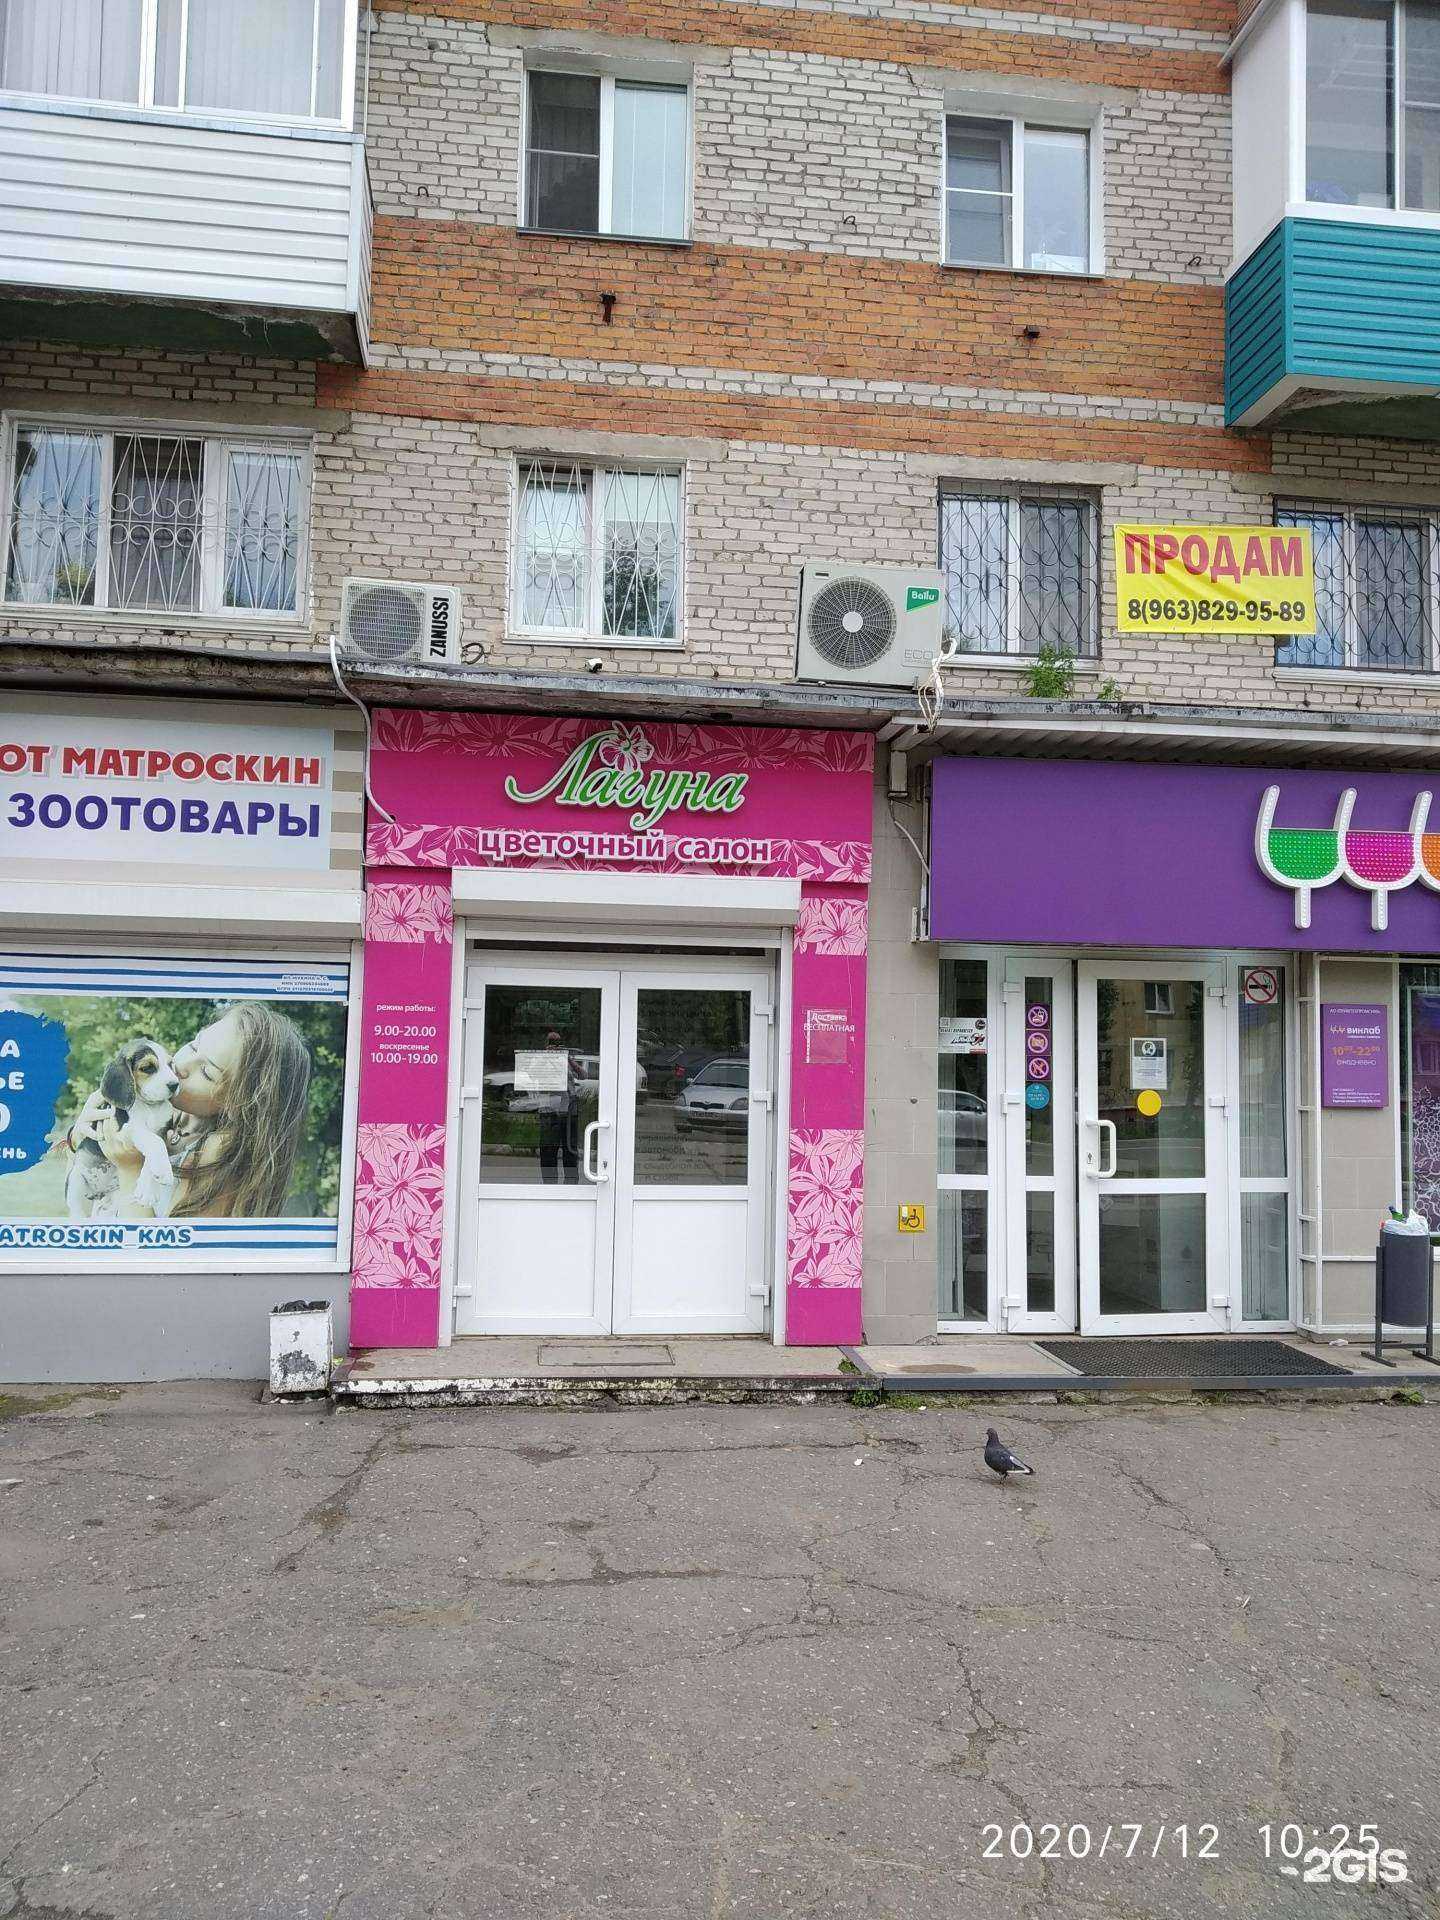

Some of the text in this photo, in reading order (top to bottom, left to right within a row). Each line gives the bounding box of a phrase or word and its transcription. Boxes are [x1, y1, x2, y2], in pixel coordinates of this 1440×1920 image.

[1124, 533, 1304, 583] ПРОДАМ
[911, 590, 935, 601] Ballu
[1127, 598, 1306, 625] 8(963)829-95-89
[430, 596, 450, 658] ZANUSSI
[62, 746, 321, 785] МАТРОСКИН
[504, 728, 748, 830] Лагуна
[8, 792, 320, 838] ЗООТОВАРЫ
[478, 829, 771, 864] цветочный салон
[376, 1003, 436, 1013] режим работы:
[374, 1025, 436, 1037] 9.00-20.00
[1346, 1025, 1381, 1034] винлаб
[371, 1052, 438, 1065] 10.00-19.00
[379, 1043, 430, 1051] воскресенье
